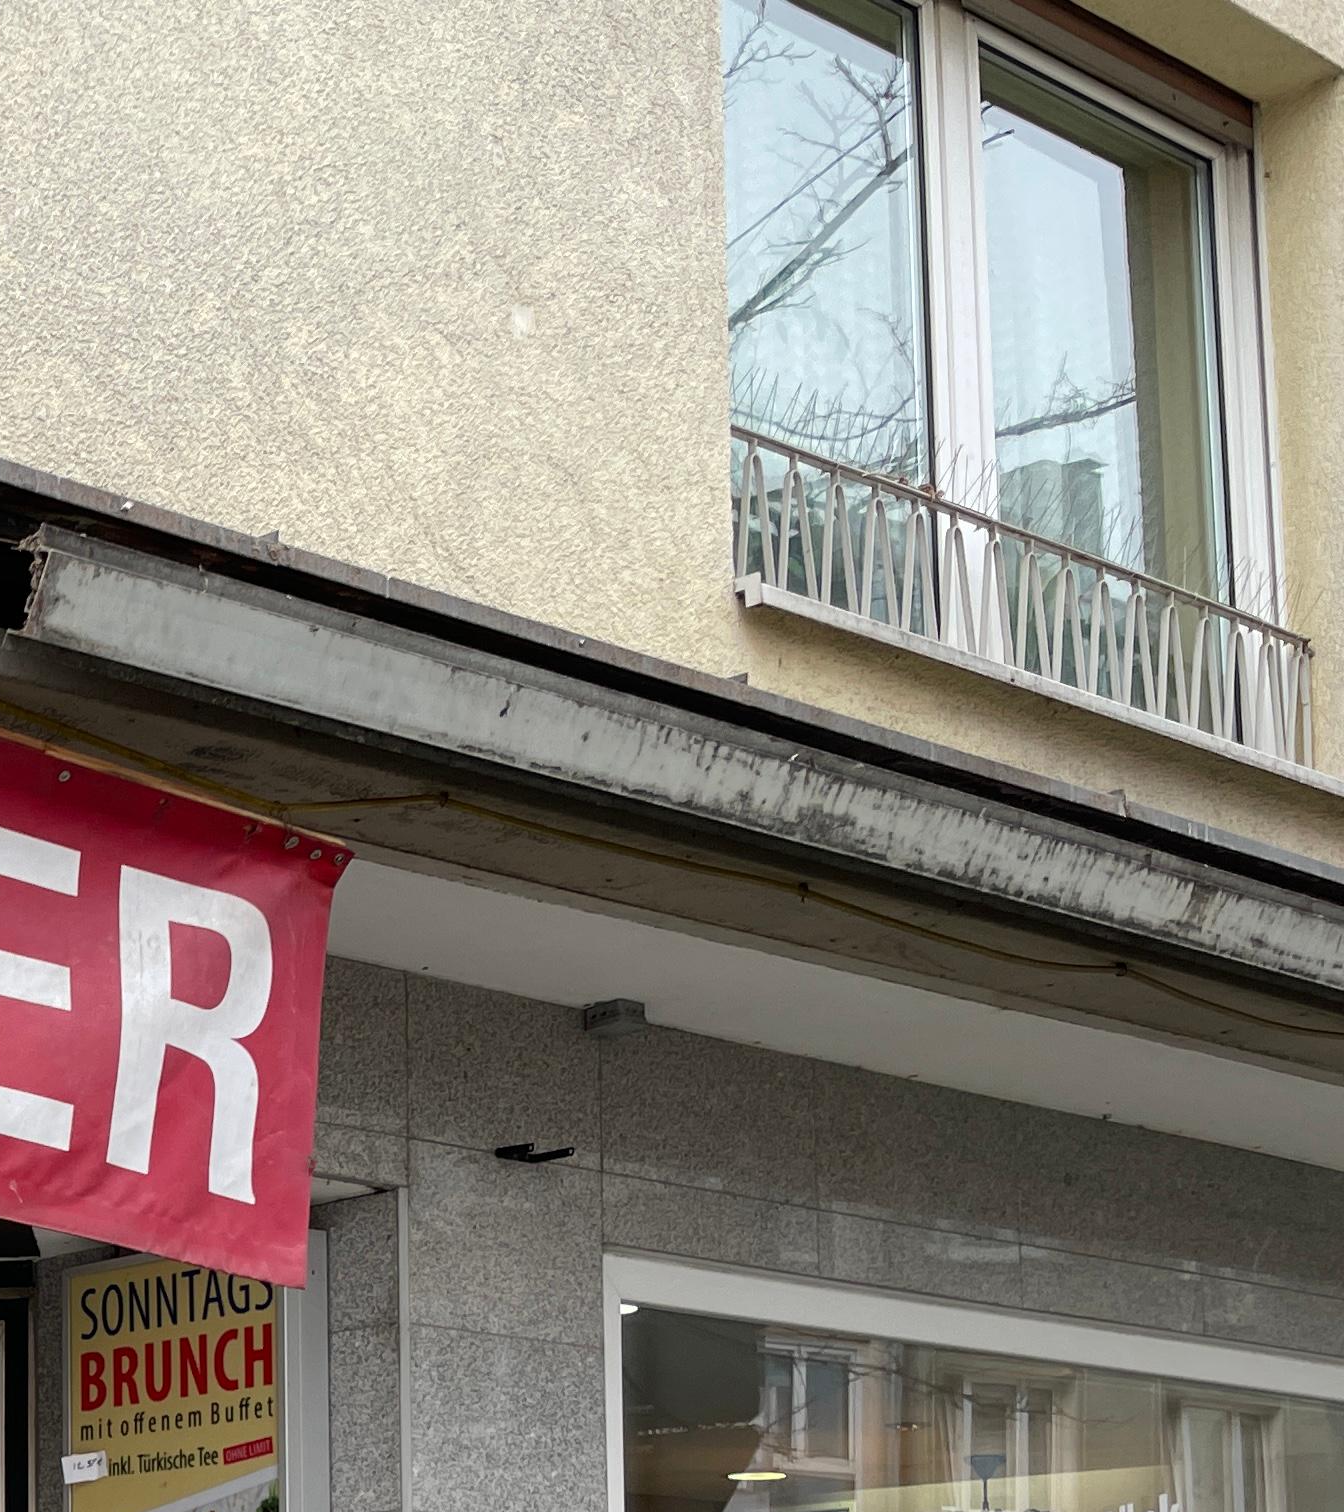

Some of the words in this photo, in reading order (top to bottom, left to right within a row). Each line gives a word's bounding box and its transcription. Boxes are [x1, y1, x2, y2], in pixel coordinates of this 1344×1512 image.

[80, 1268, 273, 1340] SONNTAGS
[80, 1323, 273, 1412] BRUNCH
[80, 1418, 113, 1441] mit
[120, 1409, 202, 1436] offenem
[211, 1397, 274, 1425] Buffet
[108, 1456, 135, 1477] inkl.
[138, 1449, 195, 1473] Türkische
[197, 1447, 219, 1467] Tee
[225, 1445, 248, 1462] OHNE
[248, 1439, 271, 1456] LIMIT
